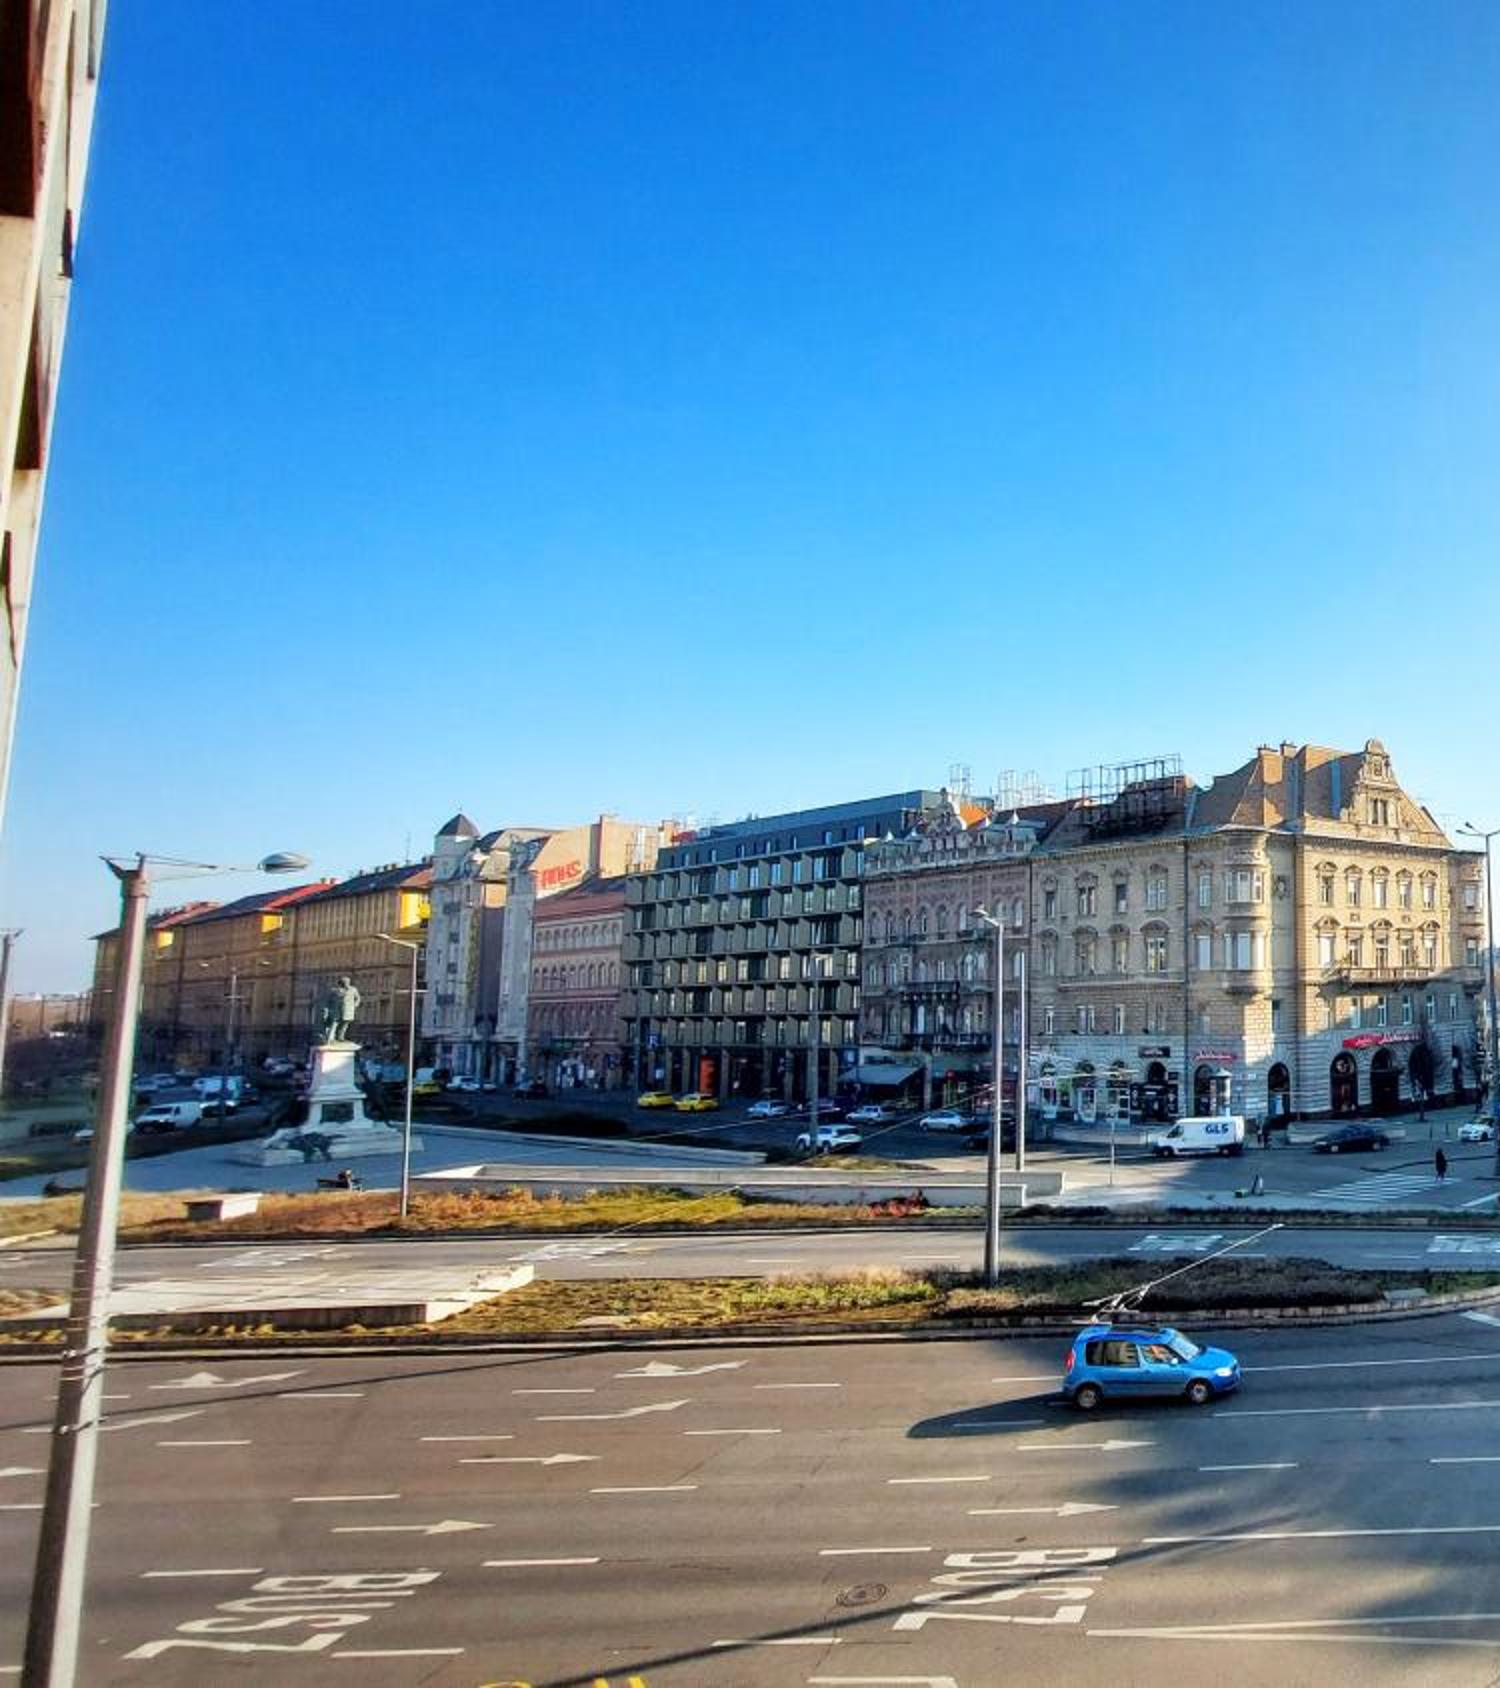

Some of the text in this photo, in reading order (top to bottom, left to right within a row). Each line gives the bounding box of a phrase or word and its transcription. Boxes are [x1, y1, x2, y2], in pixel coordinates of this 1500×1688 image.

[1205, 1122, 1229, 1135] GLS
[121, 1571, 442, 1659] BUSZ
[892, 1546, 1119, 1631] BUSZ
